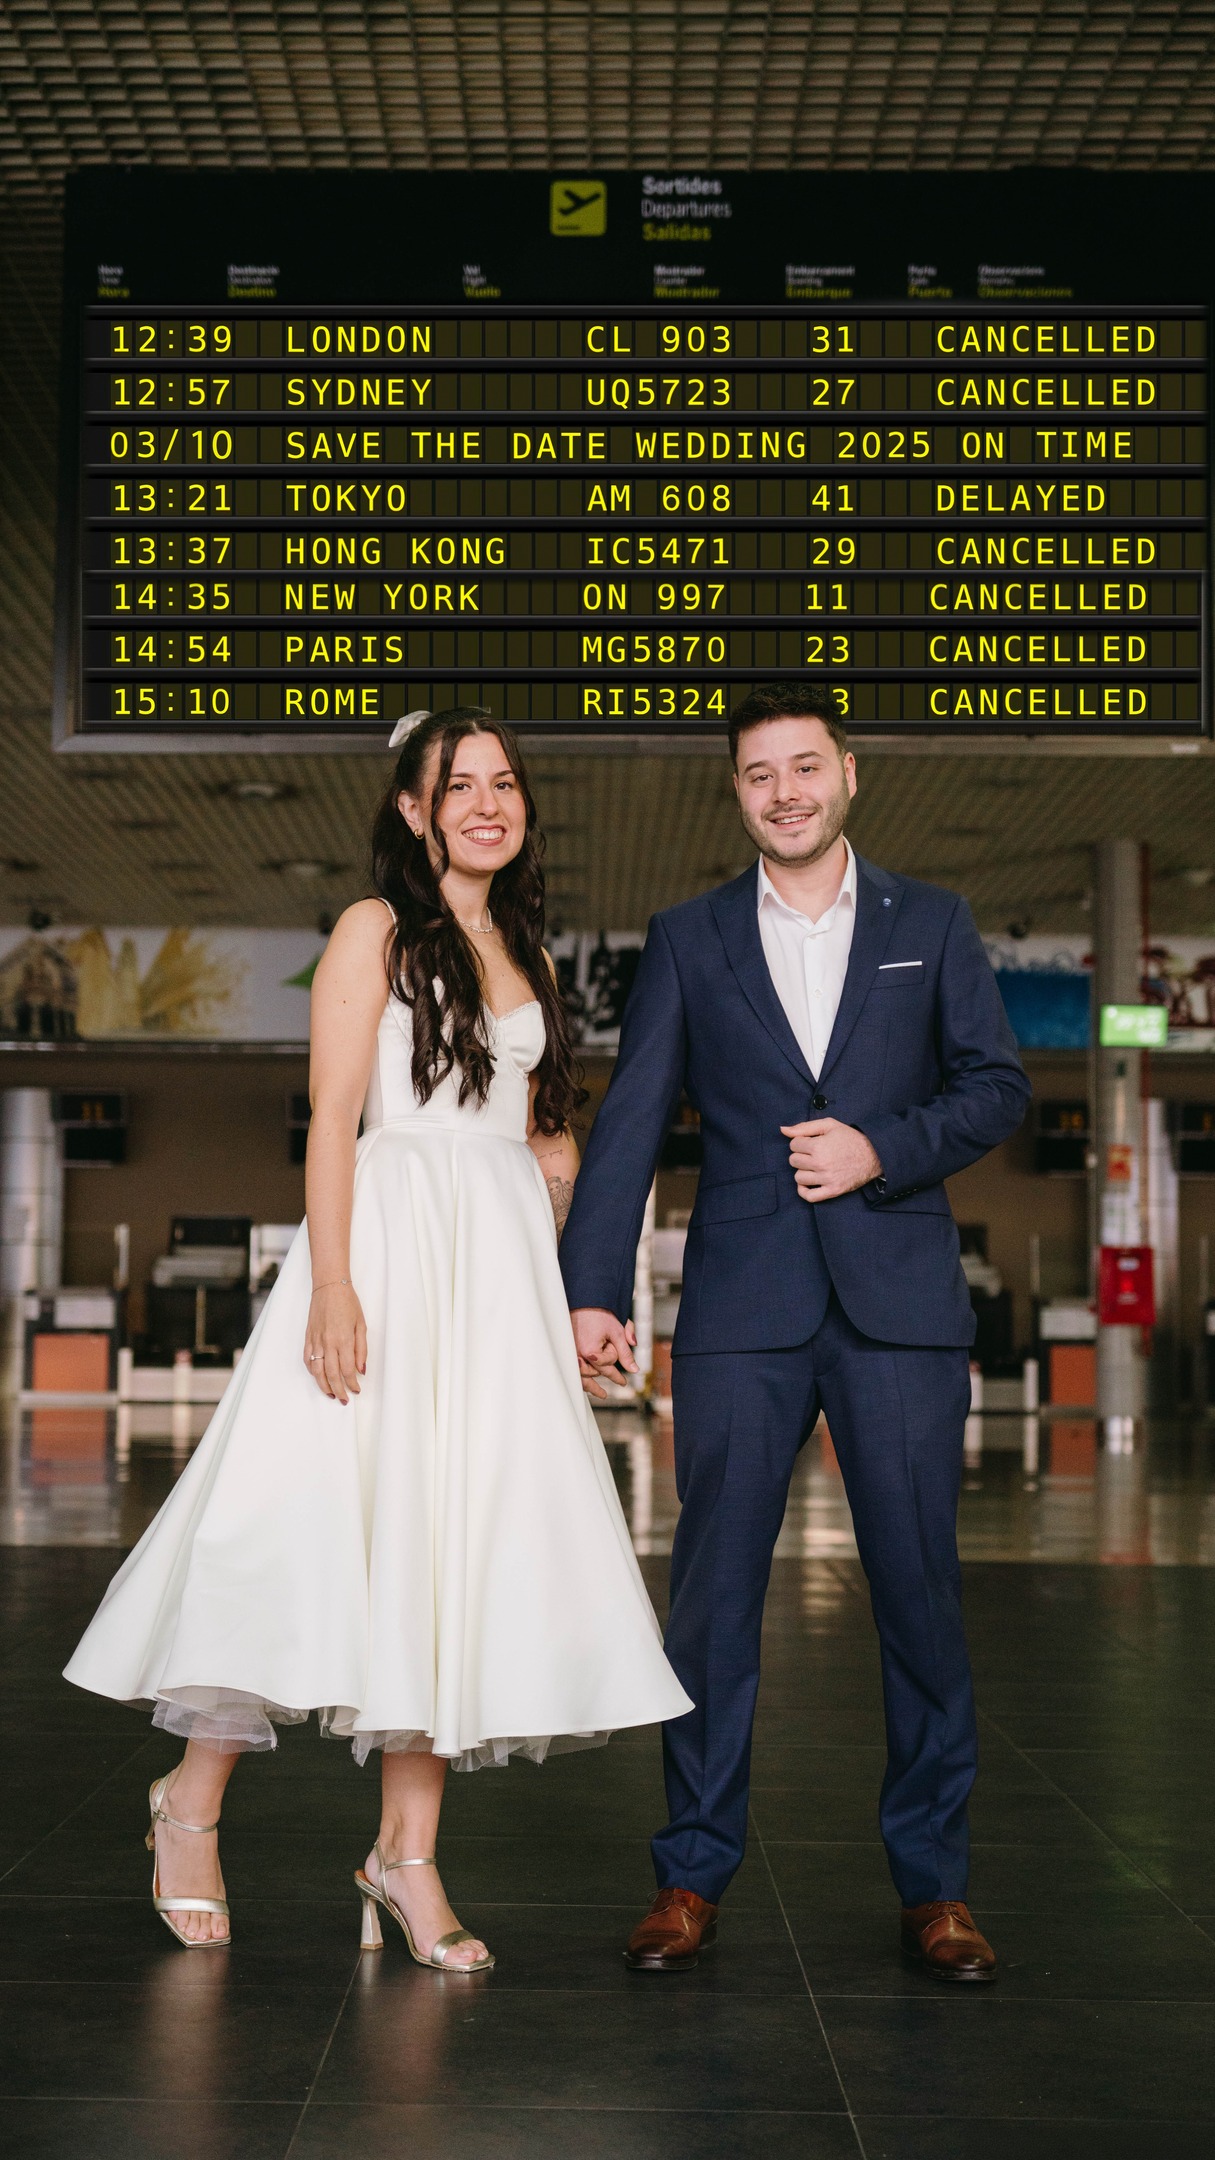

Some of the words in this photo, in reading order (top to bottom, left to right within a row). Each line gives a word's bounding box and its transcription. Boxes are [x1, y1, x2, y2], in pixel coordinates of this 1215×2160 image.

[641, 176, 722, 195] Sortides
[641, 199, 731, 219] Departures
[642, 223, 711, 241] Salidas
[113, 325, 232, 353] 12:39
[287, 325, 431, 353] LONDON
[587, 325, 631, 353] CL
[661, 325, 731, 353] 903
[812, 325, 854, 353] 31
[937, 325, 1156, 353] CANCELLED
[114, 378, 230, 406] 12:57
[287, 378, 432, 406] SYDNEY
[587, 378, 731, 409] UQ5723
[812, 378, 855, 406] 27
[937, 378, 1156, 406] CANCELLED
[110, 429, 233, 460] 03/10
[287, 431, 380, 459] SAVE
[410, 431, 481, 459] THE
[512, 432, 606, 459] DATE
[635, 431, 806, 459] WEDDING
[838, 431, 931, 459] 2025
[962, 431, 1005, 459] ON
[1036, 431, 1132, 459] TIME
[114, 484, 231, 512] 13:21
[286, 484, 406, 512] TOKYO
[587, 484, 631, 512] AM
[662, 484, 731, 512] 608
[811, 484, 854, 512] 41
[937, 484, 1105, 512] DELAYED
[114, 537, 231, 565] 13:37
[287, 537, 381, 565] HONG
[411, 537, 505, 565] KONG
[588, 537, 729, 565] IC5471
[812, 537, 856, 565] 29
[937, 537, 1156, 565] CANCELLED
[115, 583, 230, 610] 14:35
[285, 583, 356, 611] NEW
[383, 583, 480, 611] YORK
[583, 583, 627, 611] ON
[657, 583, 725, 611] 997
[807, 583, 848, 610] 11
[930, 583, 1147, 611] CANCELLED
[115, 635, 231, 663] 14:54
[286, 635, 404, 663] PARIS
[582, 635, 726, 663] MG5870
[806, 635, 850, 663] 23
[929, 635, 1146, 663] CANCELLED
[115, 688, 230, 715] 15:10
[285, 688, 379, 716] ROME
[583, 688, 726, 716] RI5324
[930, 688, 1147, 716] CANCELLED
